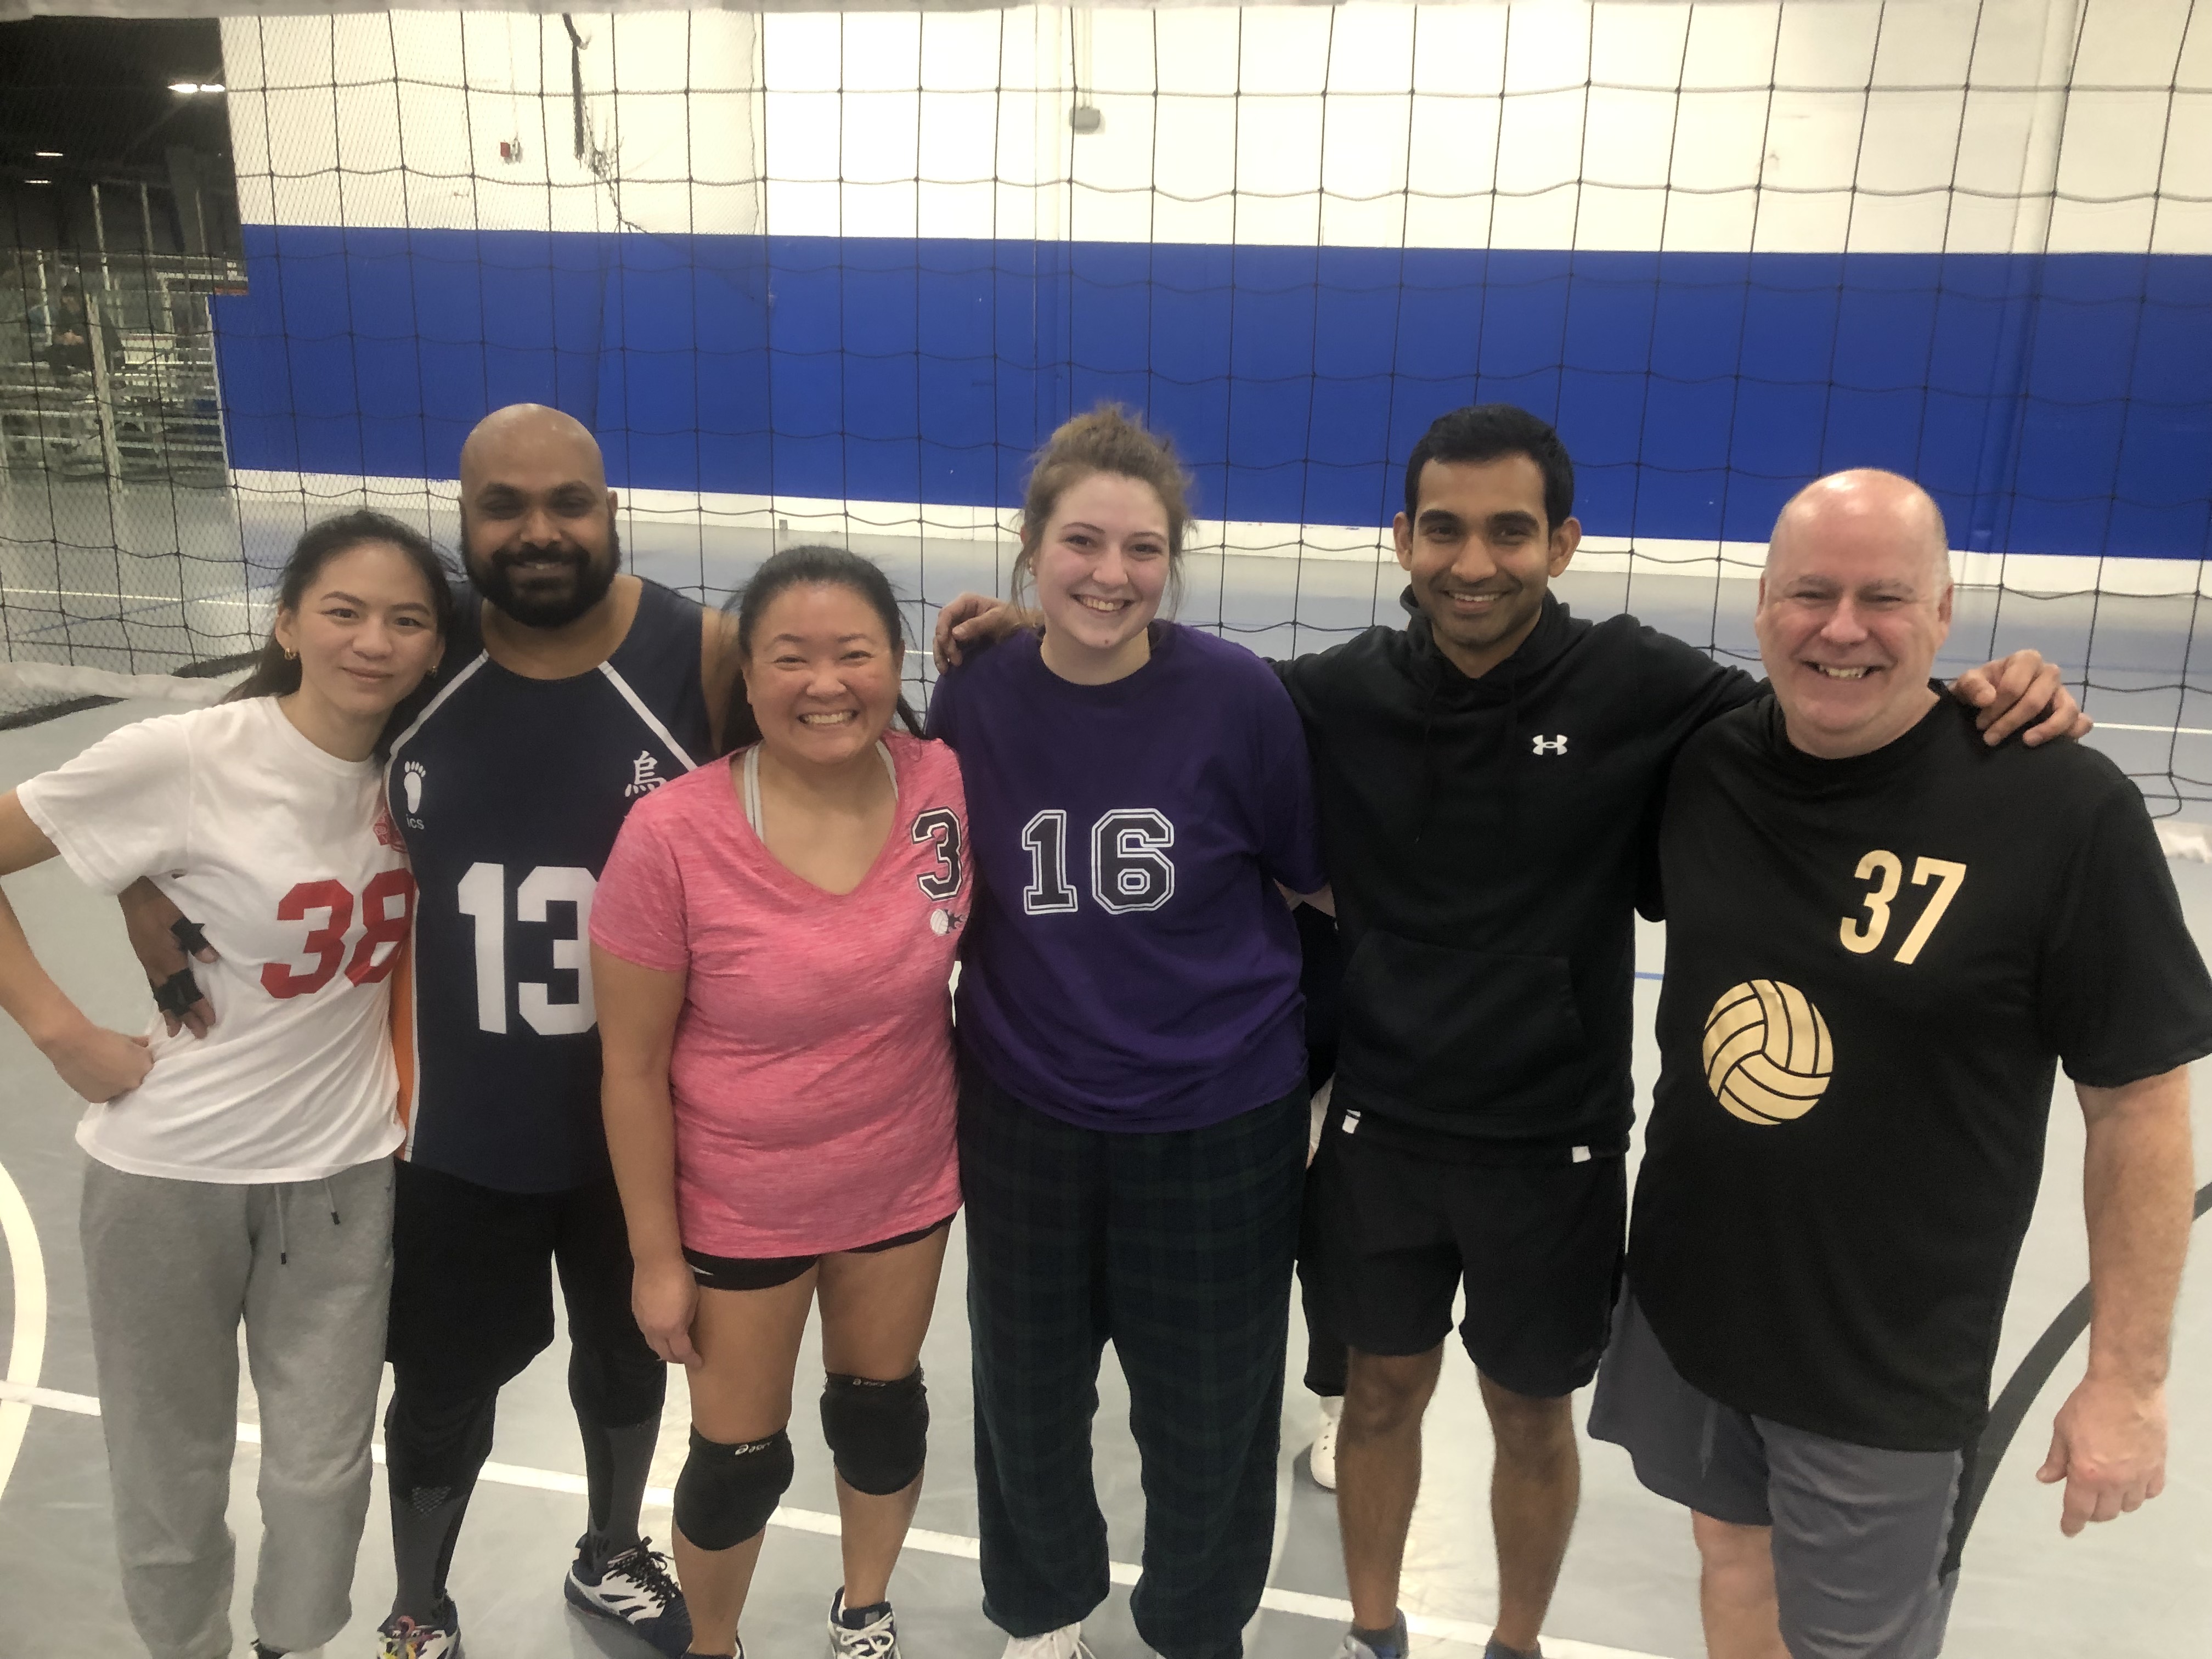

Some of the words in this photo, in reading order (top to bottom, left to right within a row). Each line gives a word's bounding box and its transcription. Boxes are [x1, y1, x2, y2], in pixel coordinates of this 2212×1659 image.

[911, 806, 963, 901] 3
[1022, 808, 1175, 915] 16
[1839, 849, 1967, 965] 37
[260, 868, 415, 1000] 38
[458, 862, 599, 1036] 13
